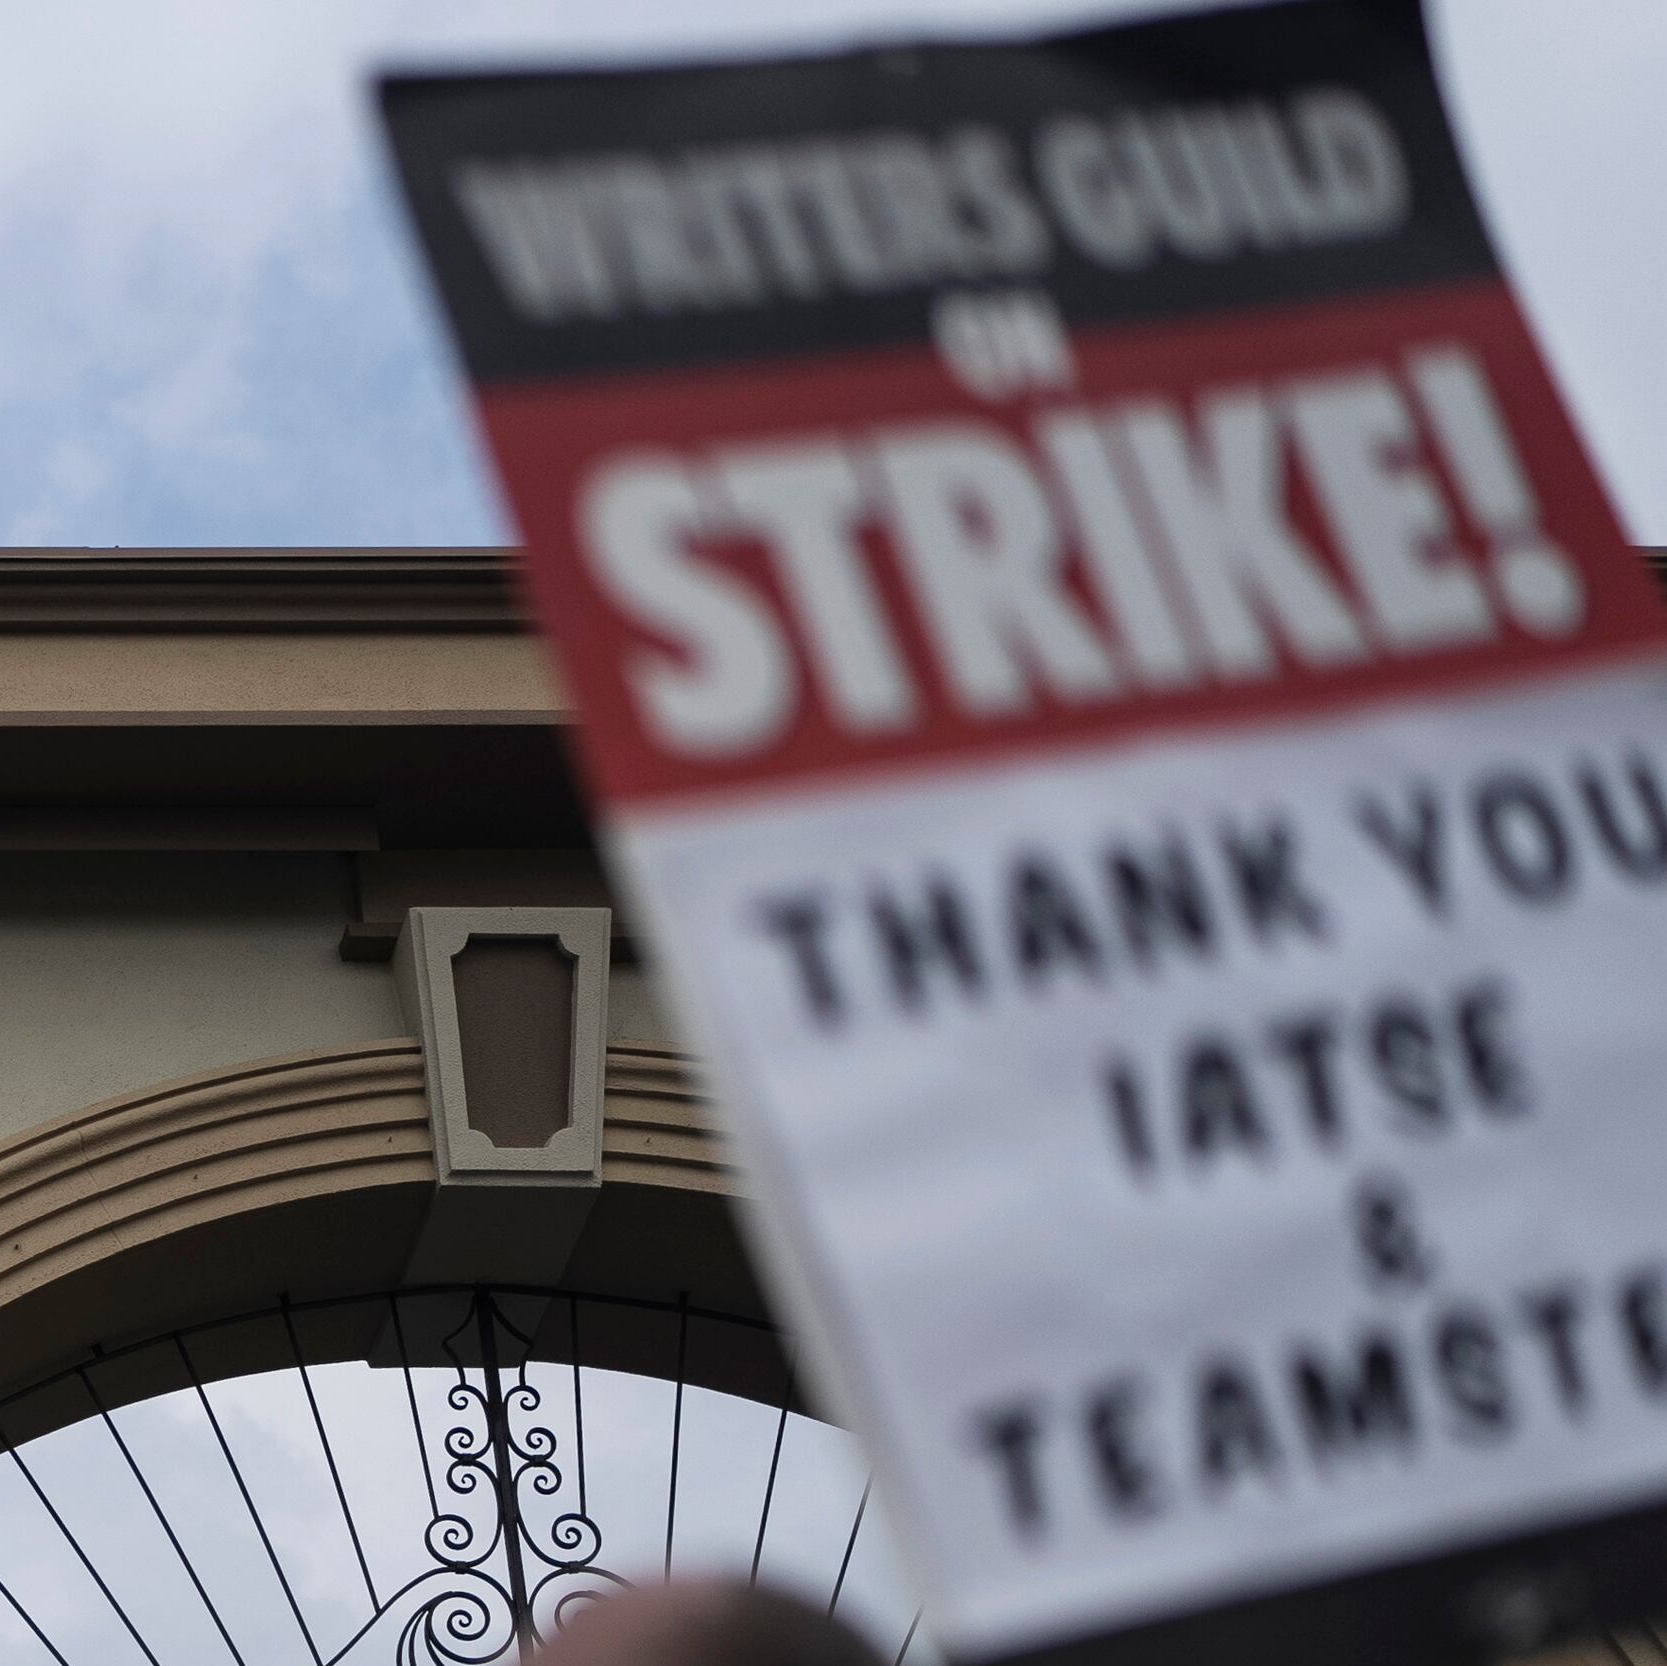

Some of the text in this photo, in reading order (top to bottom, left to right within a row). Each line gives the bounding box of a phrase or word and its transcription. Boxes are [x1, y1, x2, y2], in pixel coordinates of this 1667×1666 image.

[451, 87, 1410, 321] WRITERS GUILD
[934, 288, 1070, 394] ON
[581, 342, 1588, 759] STRIKE!
[754, 755, 1667, 1029] THANK YOU
[1105, 977, 1534, 1181] IATSE
[1351, 1172, 1439, 1292] &
